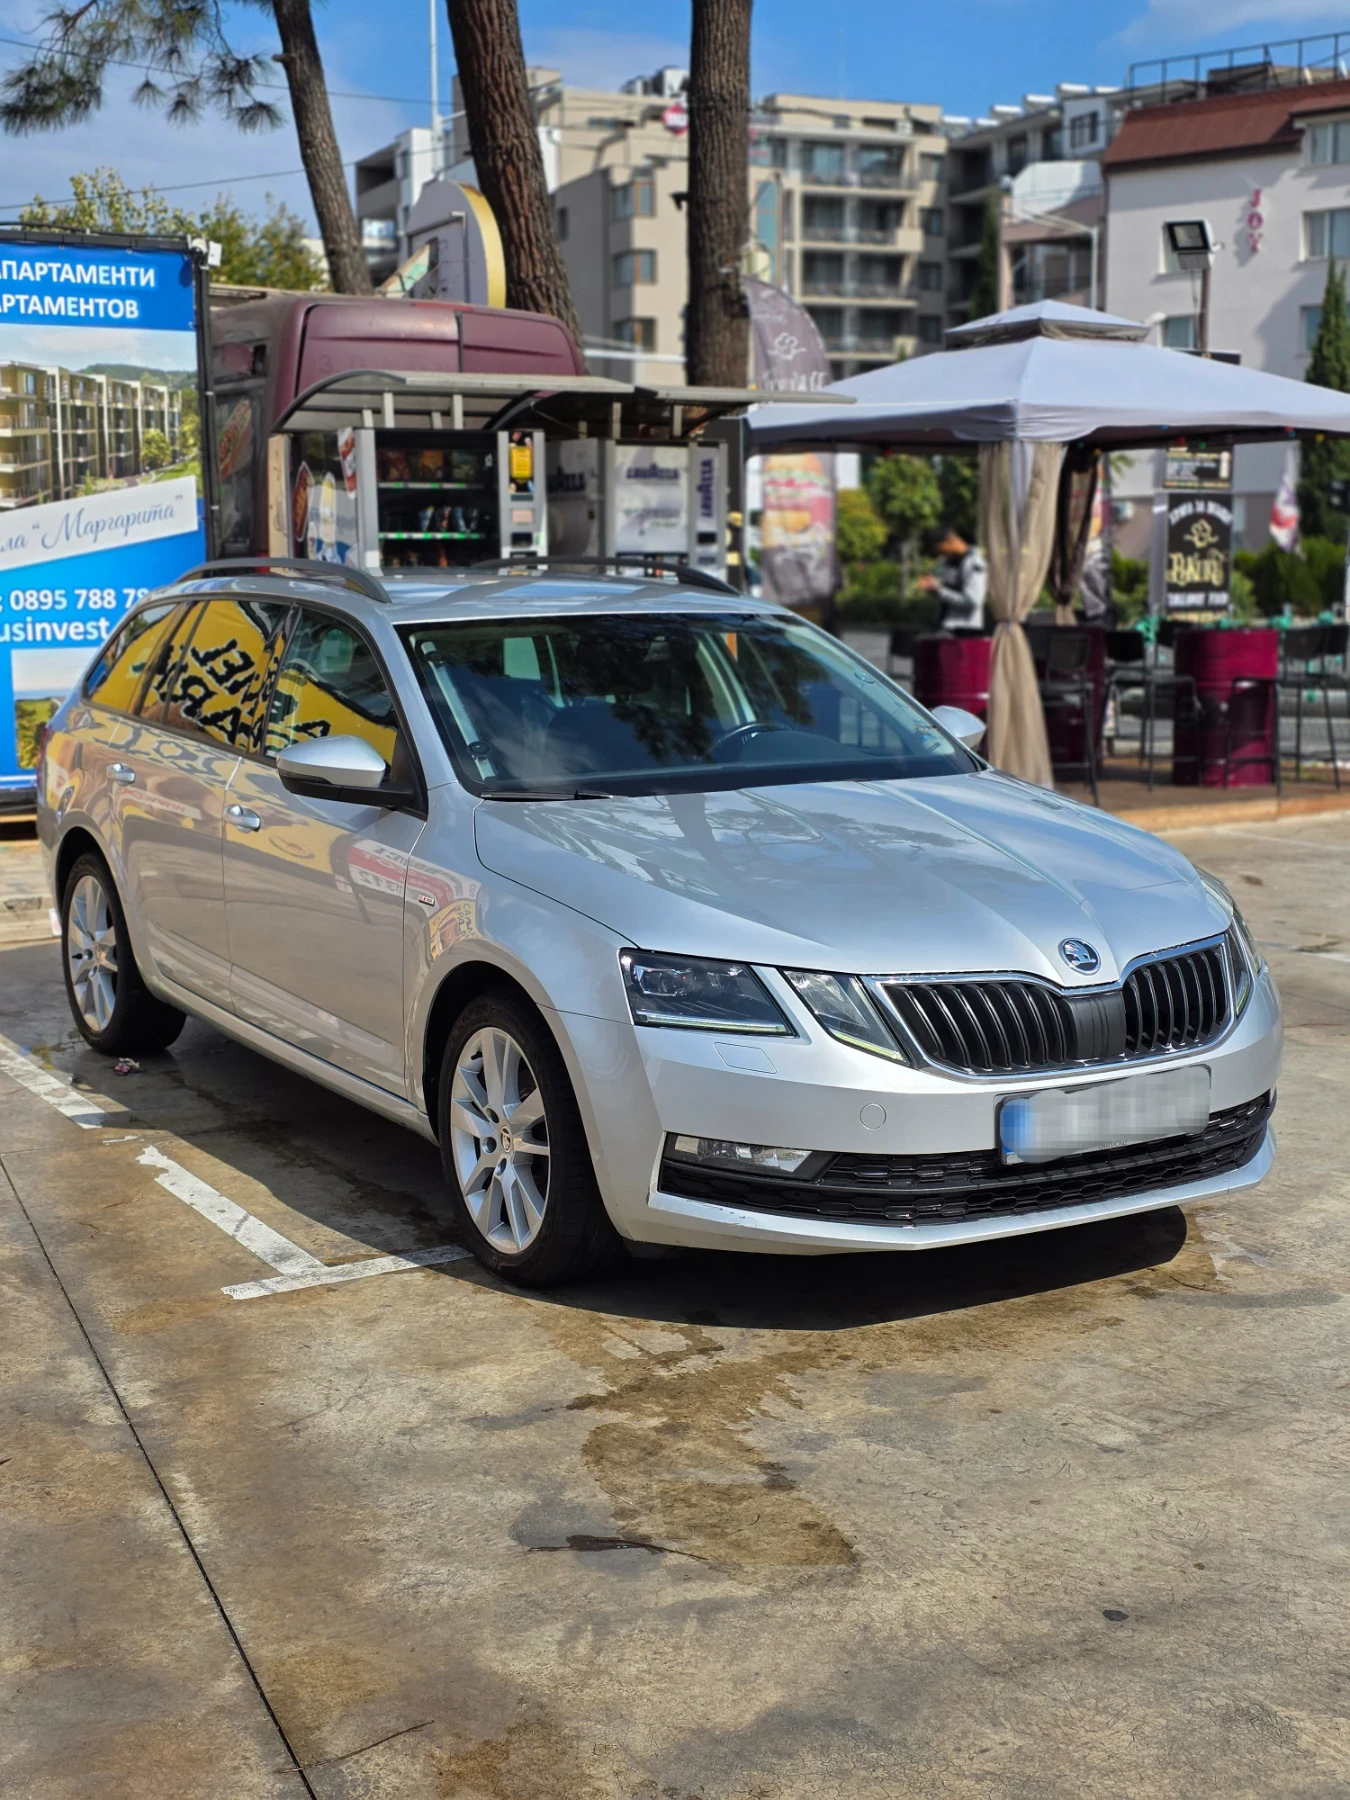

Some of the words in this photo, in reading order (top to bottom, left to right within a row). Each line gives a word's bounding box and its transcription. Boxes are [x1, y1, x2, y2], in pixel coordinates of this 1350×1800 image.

[0, 260, 156, 288] ПАРТАМЕНТИ
[0, 293, 140, 319] РТАМЕНТОВ
[10, 588, 68, 611] 0895
[74, 588, 117, 610] 788
